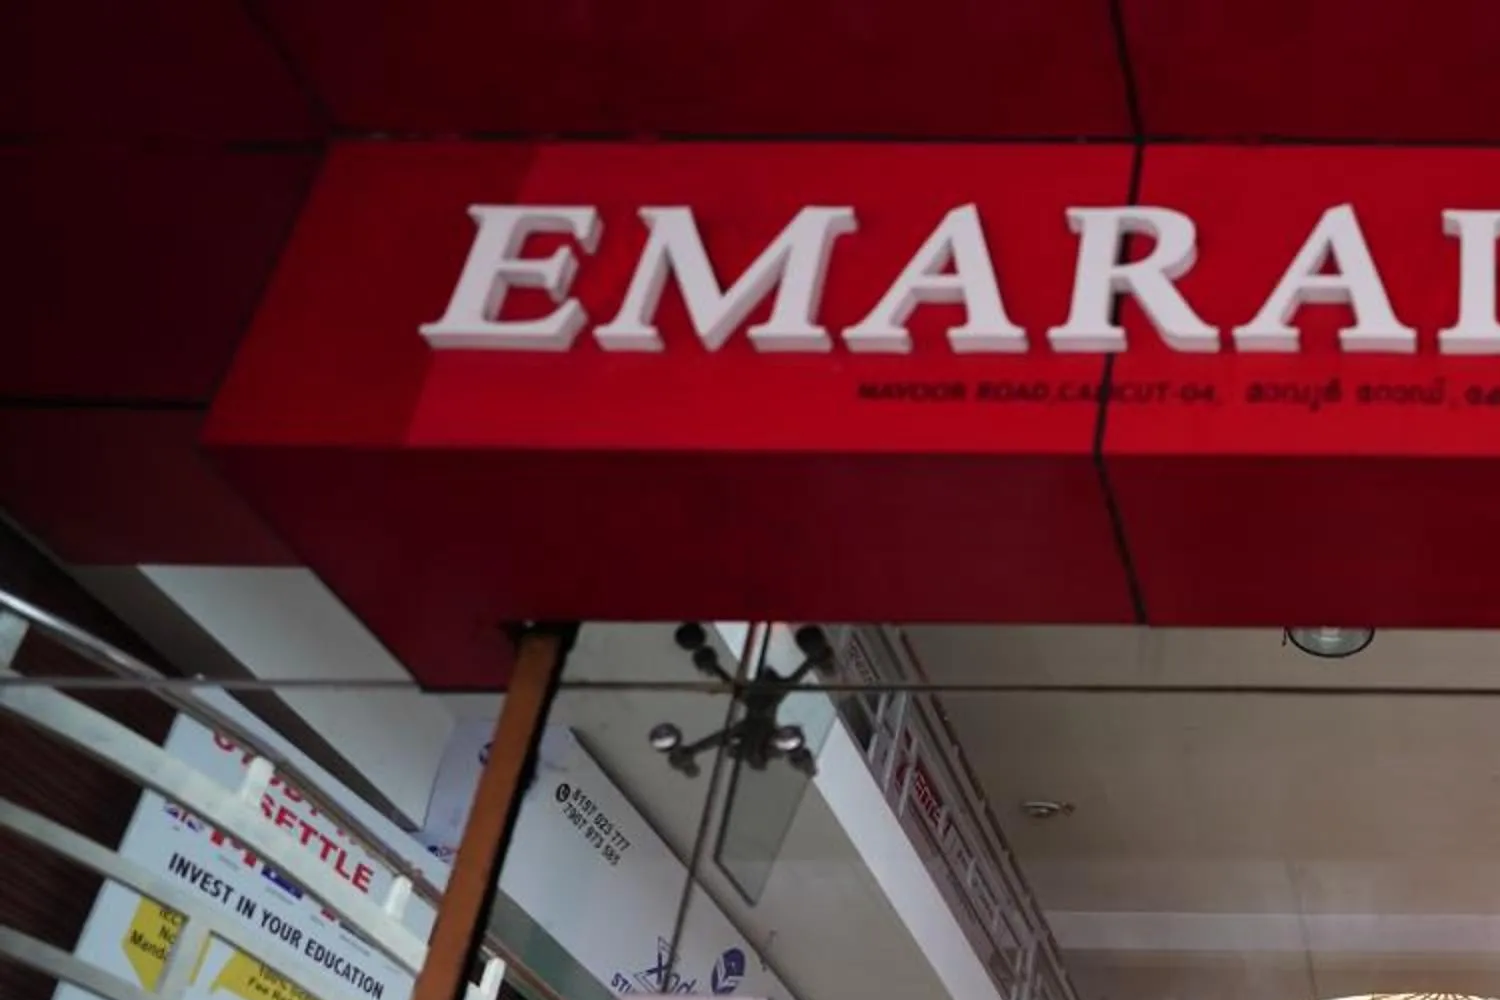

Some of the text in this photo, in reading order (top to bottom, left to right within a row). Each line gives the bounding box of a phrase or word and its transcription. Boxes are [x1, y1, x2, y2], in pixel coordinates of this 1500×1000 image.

[168, 852, 236, 905] INVEST
[237, 895, 256, 920] IN
[261, 907, 303, 950] YOUR
[304, 937, 387, 1000] EDUCATION
